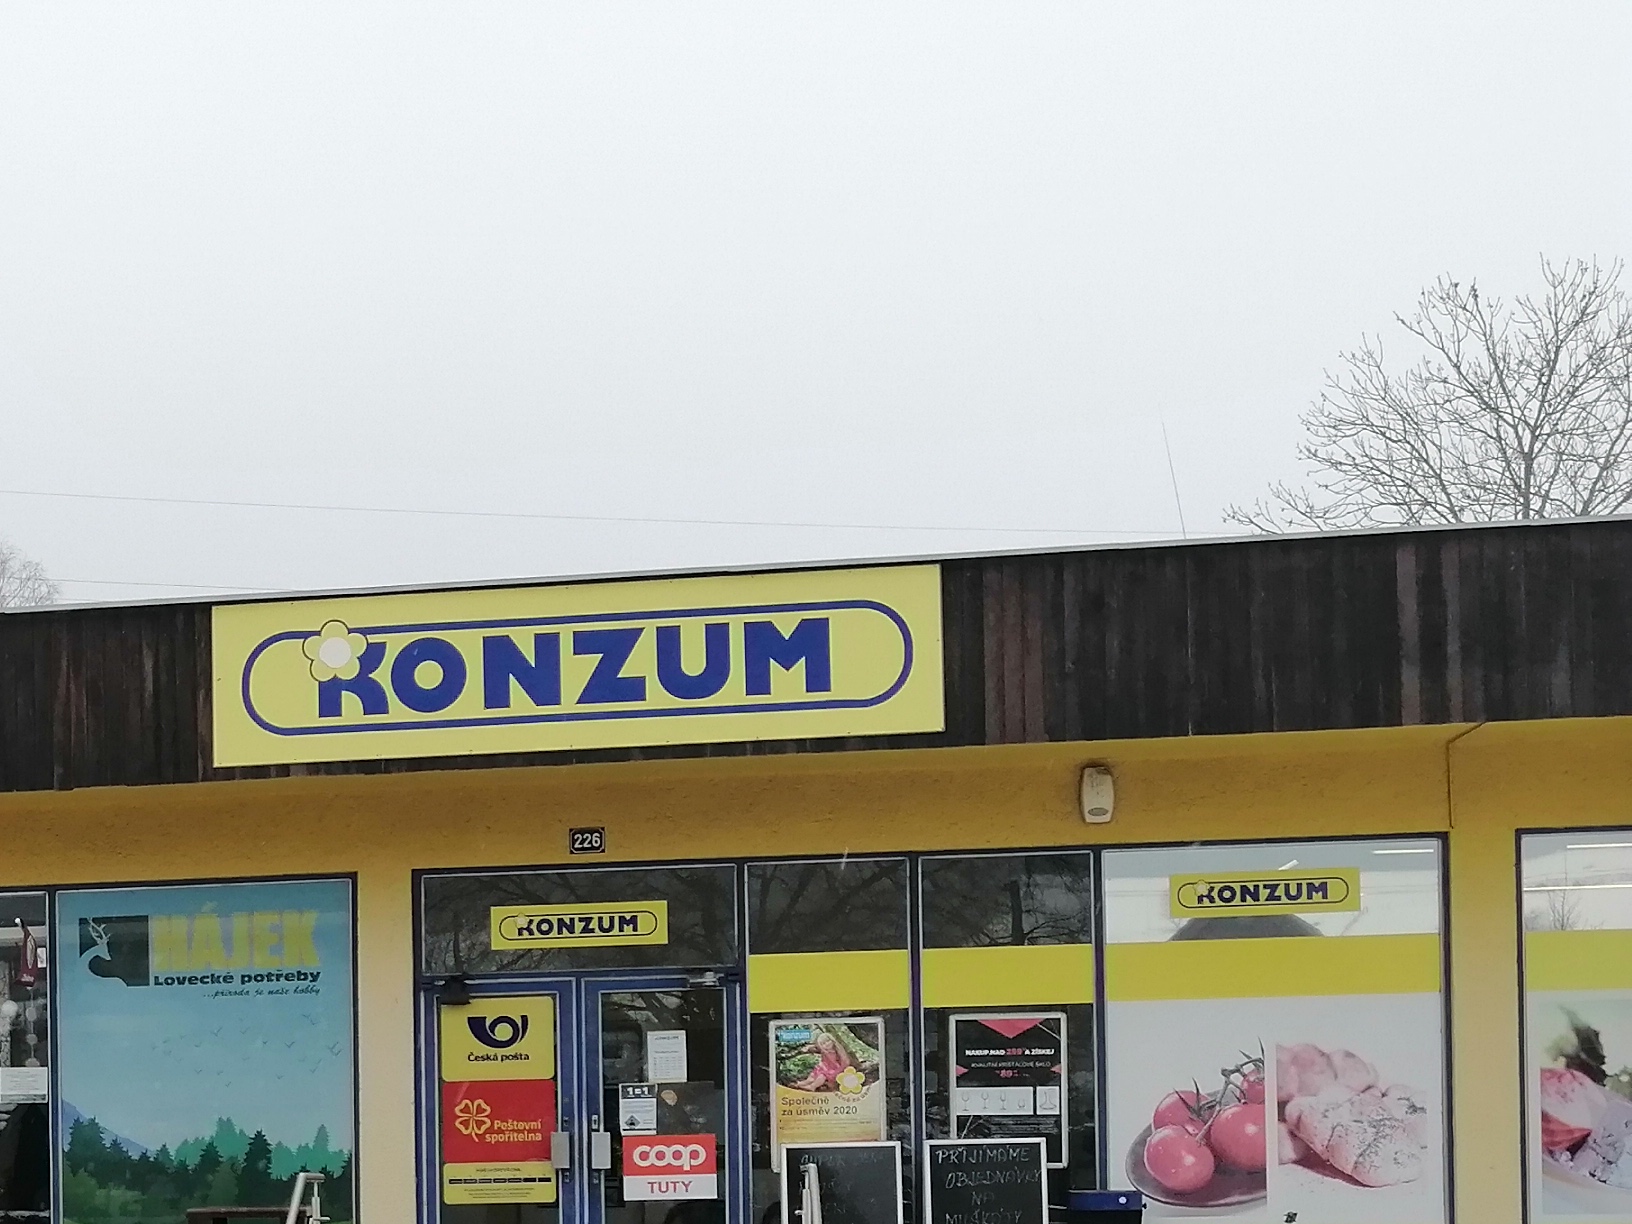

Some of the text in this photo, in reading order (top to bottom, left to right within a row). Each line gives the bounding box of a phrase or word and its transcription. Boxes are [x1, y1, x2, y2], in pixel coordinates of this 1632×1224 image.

[318, 617, 831, 718] KONZUM
[574, 833, 601, 848] 226
[1197, 881, 1329, 905] KONZUM
[517, 915, 638, 936] KONZUM
[151, 902, 320, 971] HÁJEK
[154, 969, 321, 986] Lovecké potřeby
[467, 1052, 530, 1063] Česká pošta
[781, 1096, 830, 1107] Společně
[781, 1105, 858, 1116] za úsměv 2020
[494, 1118, 542, 1130] Poštovní
[485, 1130, 543, 1145] spořitelna
[633, 1143, 707, 1171] coop
[647, 1180, 694, 1194] TUTY
